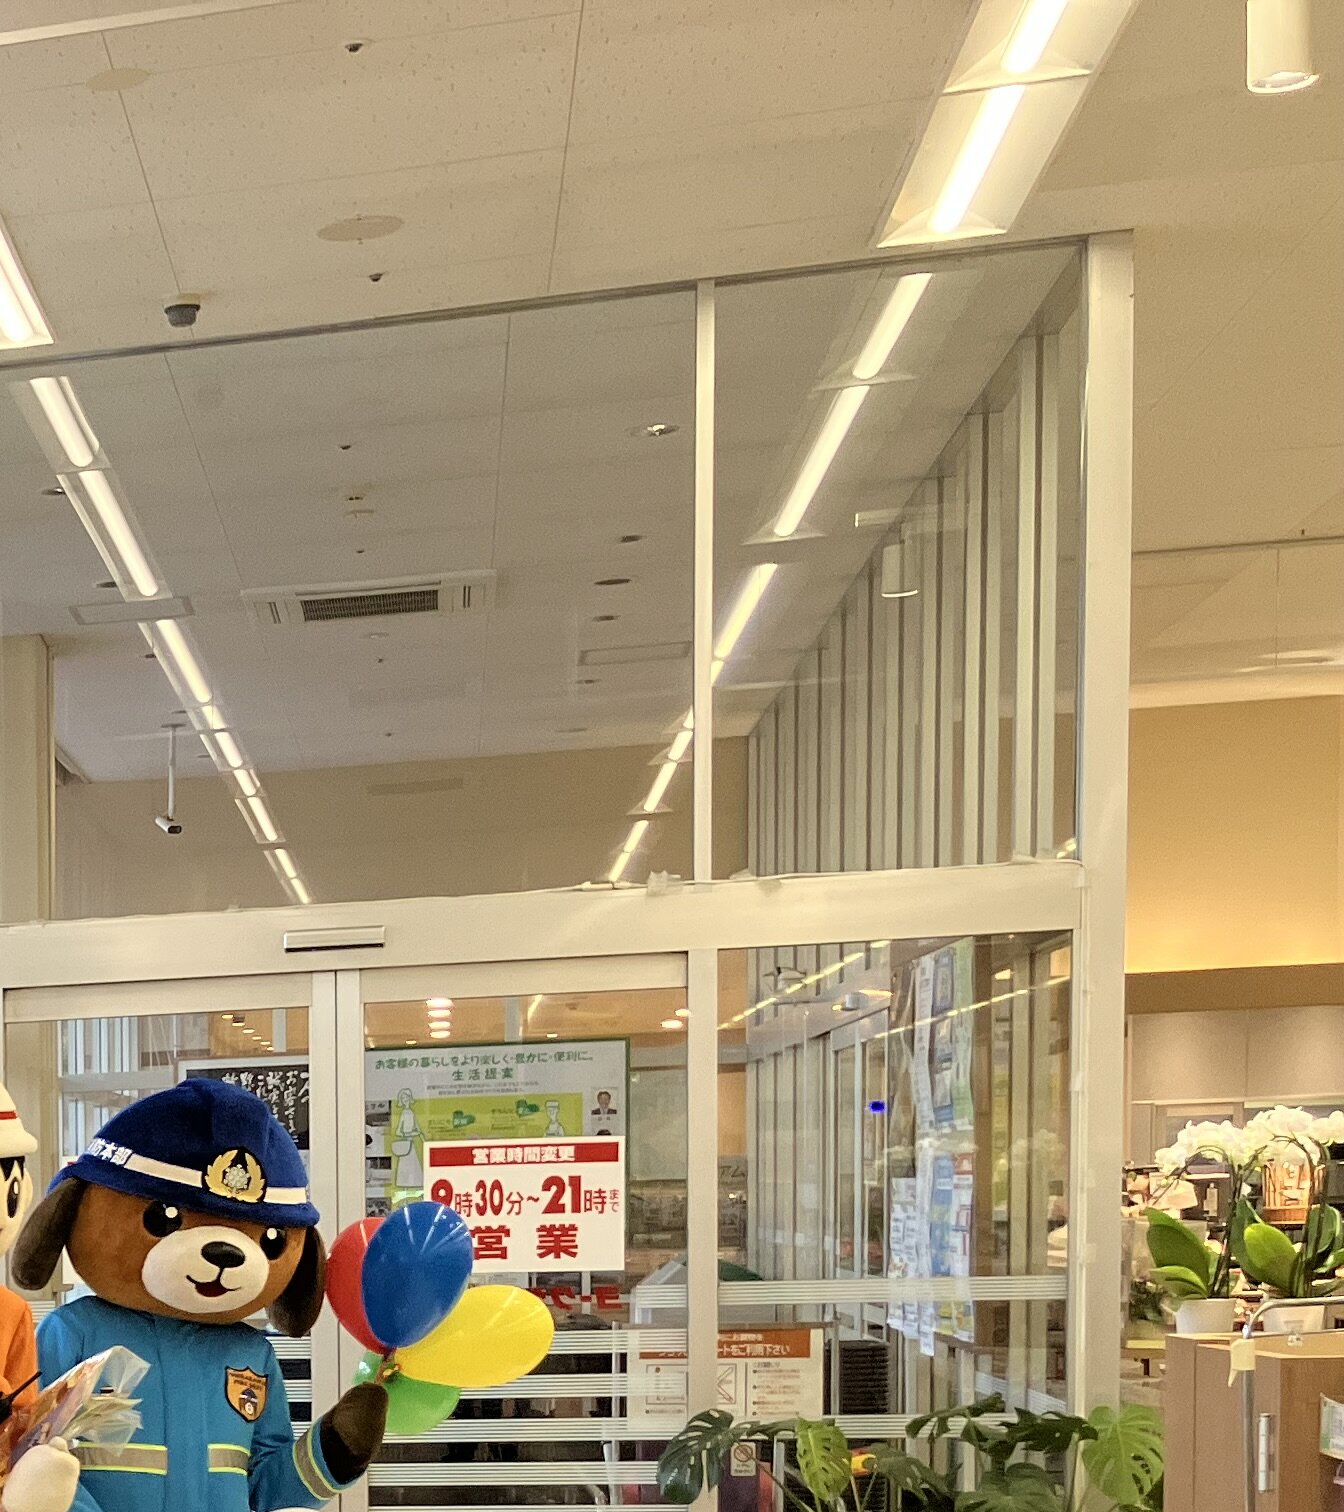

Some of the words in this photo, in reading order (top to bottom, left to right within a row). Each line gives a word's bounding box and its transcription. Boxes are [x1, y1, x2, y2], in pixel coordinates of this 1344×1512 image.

[472, 1146, 576, 1164] 営業時間変更
